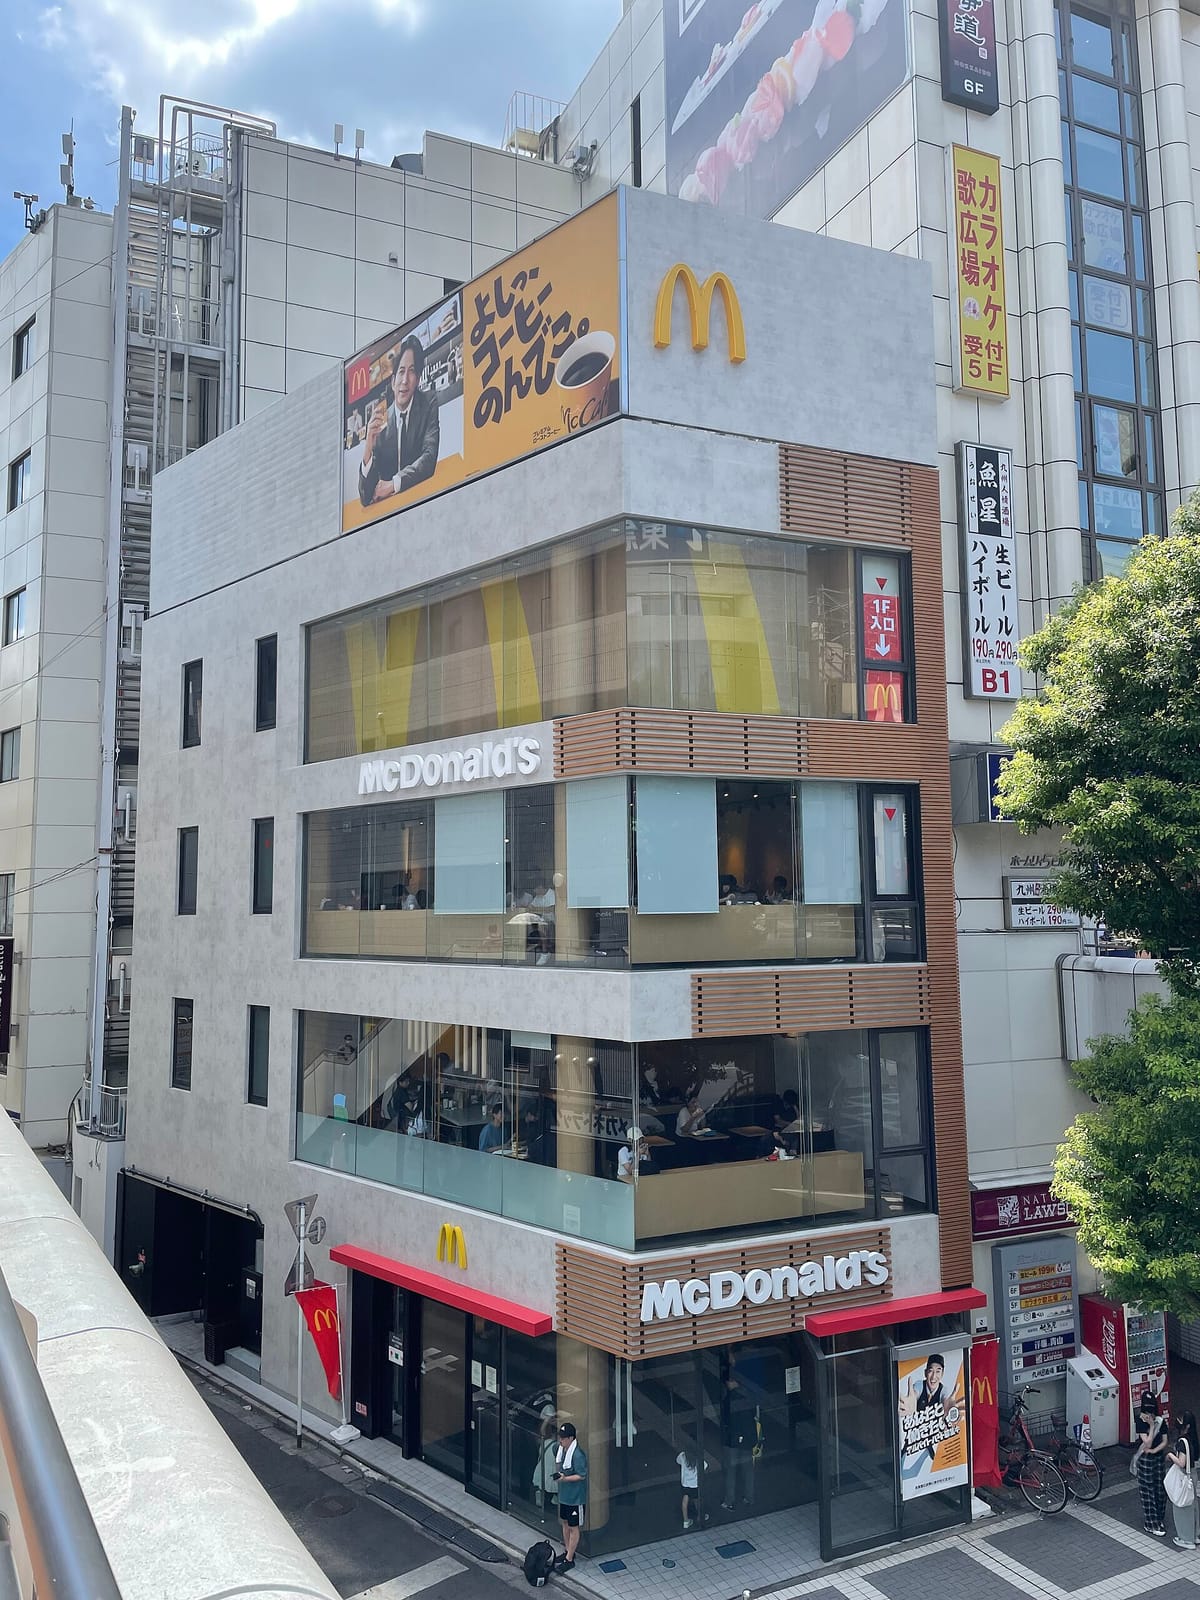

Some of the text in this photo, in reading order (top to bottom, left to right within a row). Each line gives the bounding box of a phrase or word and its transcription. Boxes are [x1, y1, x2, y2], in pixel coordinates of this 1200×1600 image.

[964, 79, 984, 95] 6F
[956, 168, 980, 288] 歌広場
[978, 175, 1003, 332] カラオケ
[472, 281, 553, 389] コーヒー
[964, 334, 1004, 361] 受付
[473, 310, 590, 429] のんでこ。
[968, 360, 1003, 382] 5F
[561, 387, 609, 434] McCaf
[968, 461, 977, 519] うおせい
[978, 460, 1000, 524] 魚星
[971, 540, 991, 635] ハイボール
[995, 543, 1014, 637] 生ビール
[872, 598, 891, 614] 1F
[870, 615, 895, 632] 入口
[972, 638, 995, 659] 190円
[995, 639, 1018, 660] 290円
[981, 668, 1010, 693] B1
[358, 736, 541, 795] McDonald's
[1017, 906, 1045, 916] 生ビール
[1018, 916, 1046, 926] ハイボール
[1023, 1193, 1057, 1206] NATU
[640, 1249, 890, 1322] McDonald's
[904, 1402, 945, 1430] あなたと
